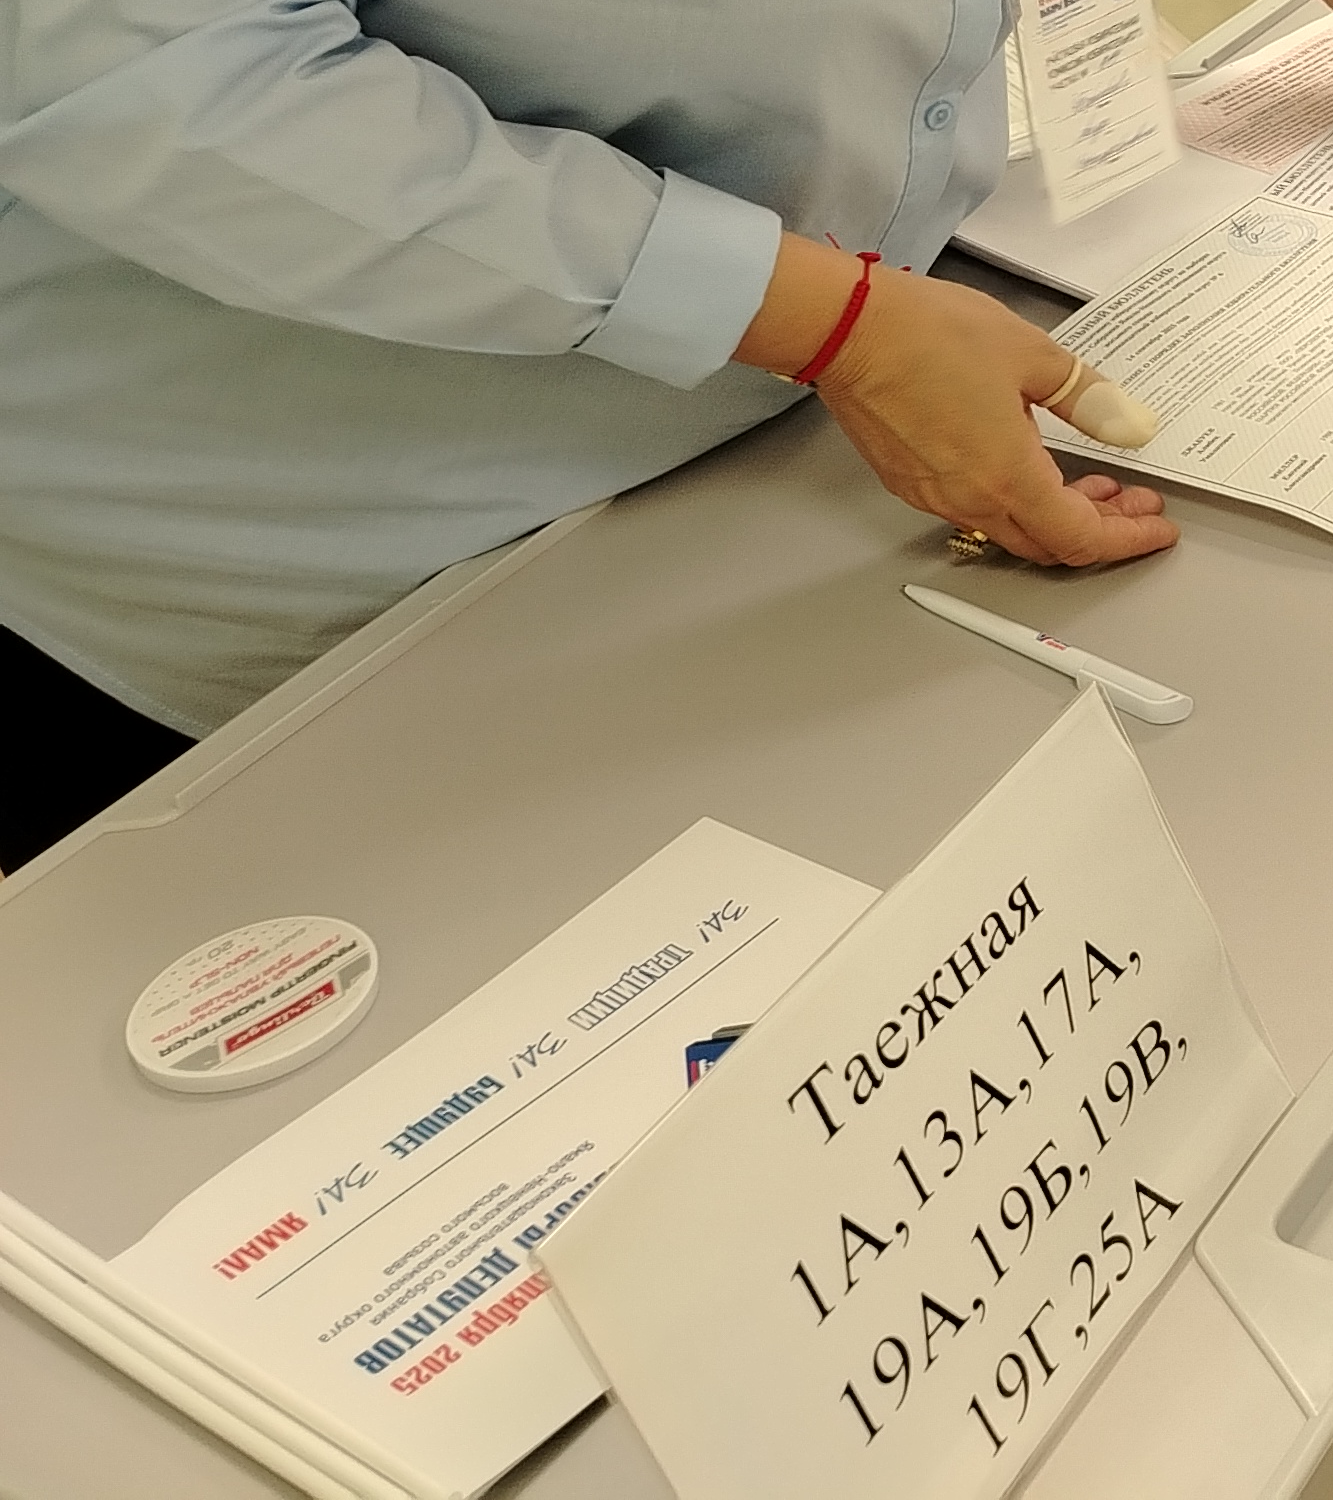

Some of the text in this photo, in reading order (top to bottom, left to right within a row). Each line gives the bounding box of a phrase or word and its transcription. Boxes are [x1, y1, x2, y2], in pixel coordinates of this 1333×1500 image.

[1107, 265, 1175, 312] БЮЛЛЕТЕНЬ
[158, 940, 358, 1058] FINGERTIP MOISTENER
[229, 987, 331, 1050] Berlingo
[788, 876, 1044, 1145] Таежная
[213, 899, 749, 1280] ЗА! ТРАДИЦИИ ЗА! БУДУЩЕЕ ЗА! ЯМАЛ!
[318, 1140, 595, 1343] Ямало-Ненецкого автономного округа
[369, 1171, 577, 1326] Законодательного Собрания
[383, 1182, 510, 1276] восьмого созыва
[354, 1247, 520, 1374] ДЕПУТАТОВ
[390, 1343, 462, 1396] 2025
